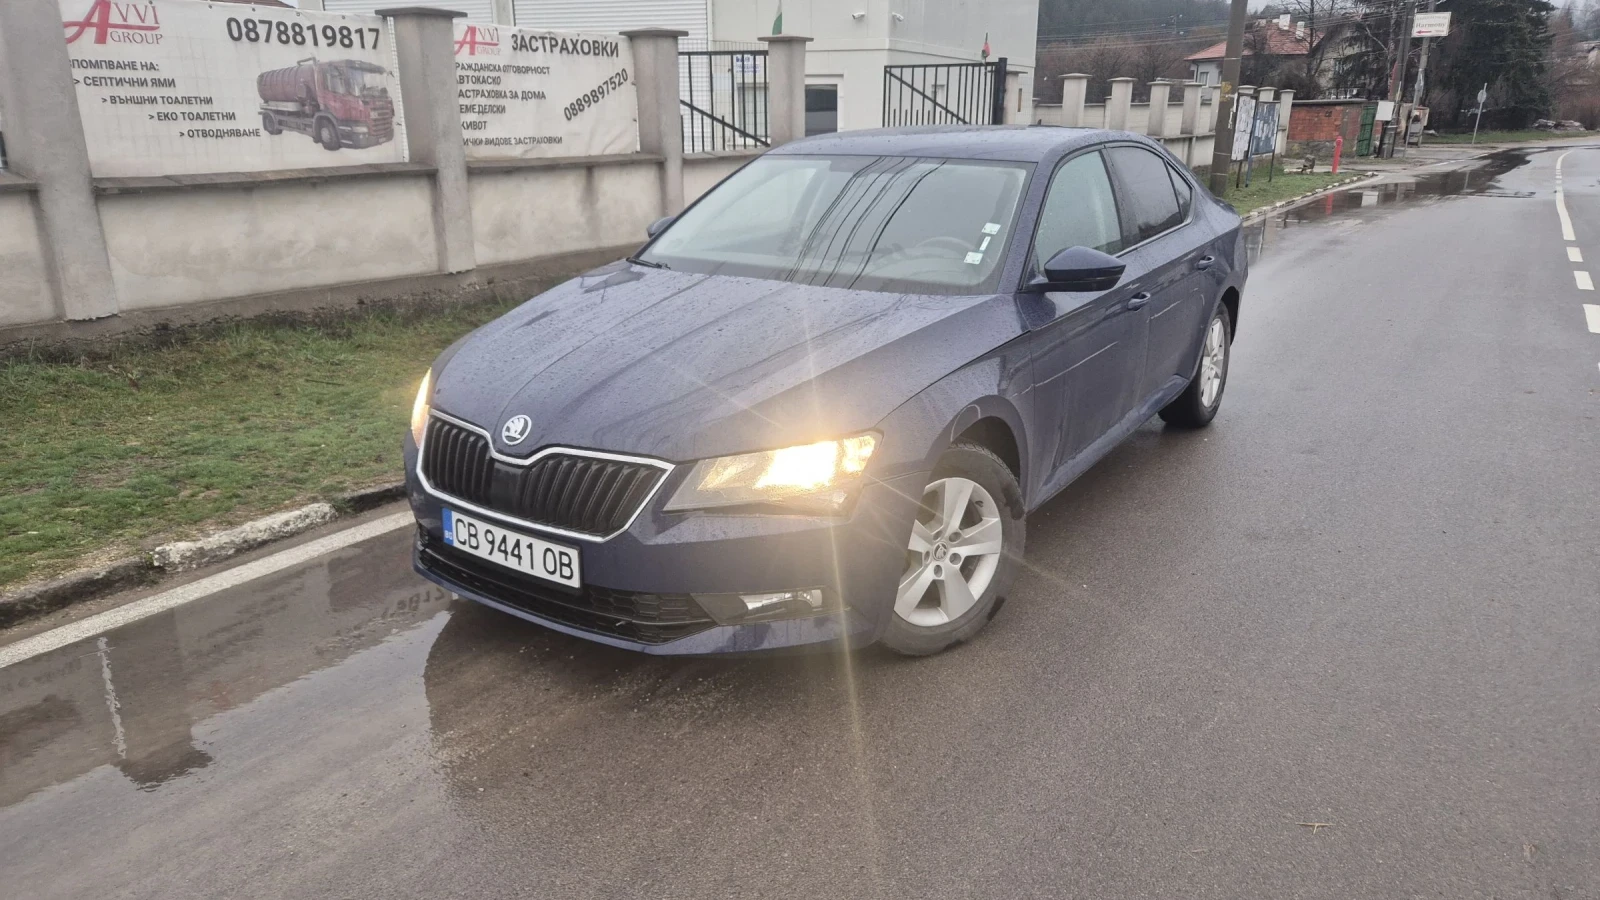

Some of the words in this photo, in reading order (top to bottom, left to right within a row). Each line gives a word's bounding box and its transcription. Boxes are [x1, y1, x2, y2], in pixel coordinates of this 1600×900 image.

[109, 30, 163, 45] GROUP
[226, 17, 380, 50] 0878819817
[511, 33, 619, 58] ЗАСТРАХОВКИ
[70, 59, 139, 71] ПОМПВАНЕ
[140, 61, 159, 71] НА:
[455, 62, 501, 73] РАЖДАНСКА
[83, 76, 148, 88] СЕПТИЧНИ
[150, 77, 176, 88] ЯМИ
[109, 95, 158, 106] ВЪНШНИ
[159, 95, 213, 105] ТОАЛЕТНИ
[458, 89, 508, 100] АСТРАХОВКА
[508, 90, 519, 100] ЗА
[521, 90, 546, 101] ДОМА
[563, 68, 628, 121] 0889897520
[459, 104, 506, 115] ЕМЕДЕЛСКИ
[157, 112, 178, 121] ЕКО
[180, 112, 236, 121] ТОАЛЕТНИ
[187, 128, 261, 139] ОТВОДНЯВАНЕ
[463, 137, 483, 146] ИЧКИ
[484, 137, 513, 147] ВИДОВЕ
[514, 136, 563, 145] ЗАСТРАХОВКИ
[455, 518, 480, 550] CB
[484, 529, 535, 570] 9441
[543, 547, 574, 580] OB
